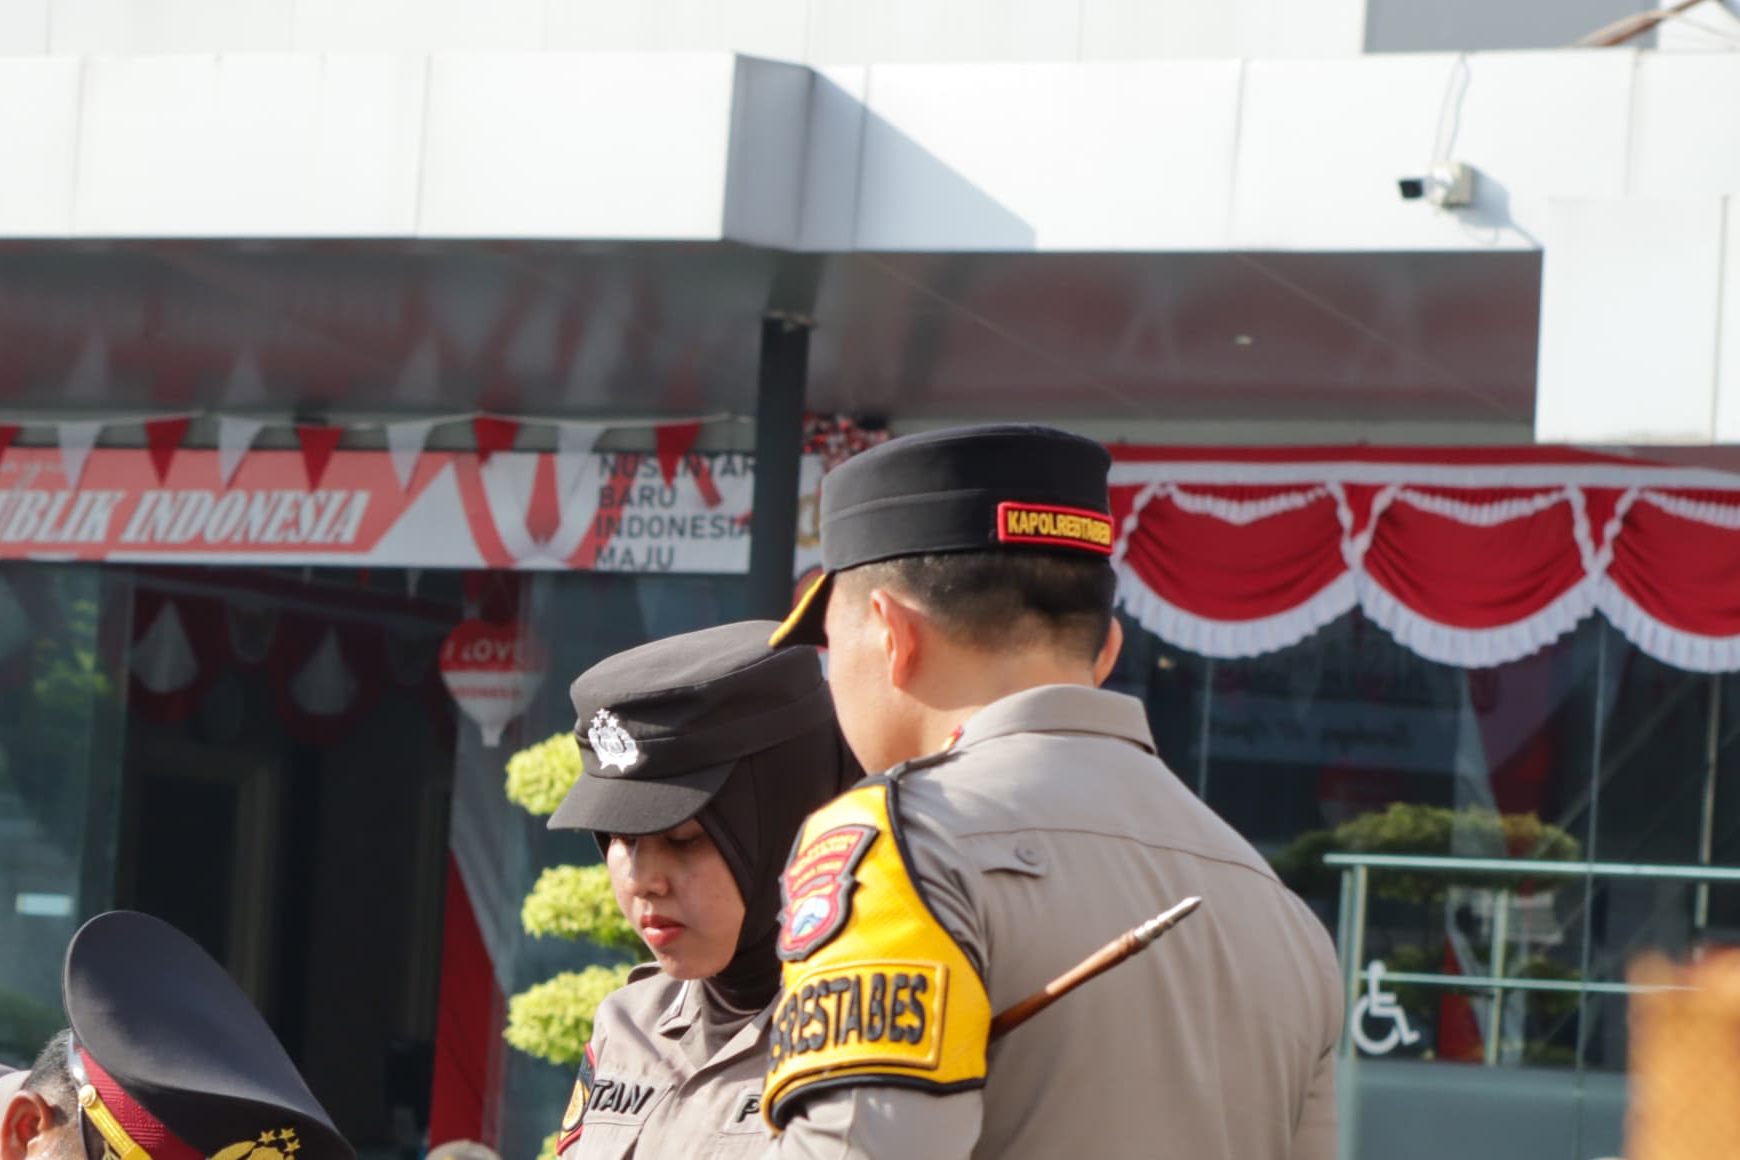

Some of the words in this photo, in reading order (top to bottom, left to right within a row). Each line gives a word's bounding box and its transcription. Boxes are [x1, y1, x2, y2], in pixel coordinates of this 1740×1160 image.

[599, 454, 756, 479] NUSNTAR
[599, 485, 677, 509] BARU
[119, 489, 371, 546] INDONESIA
[595, 515, 753, 540] INDONESIA
[595, 547, 675, 570] MAJU
